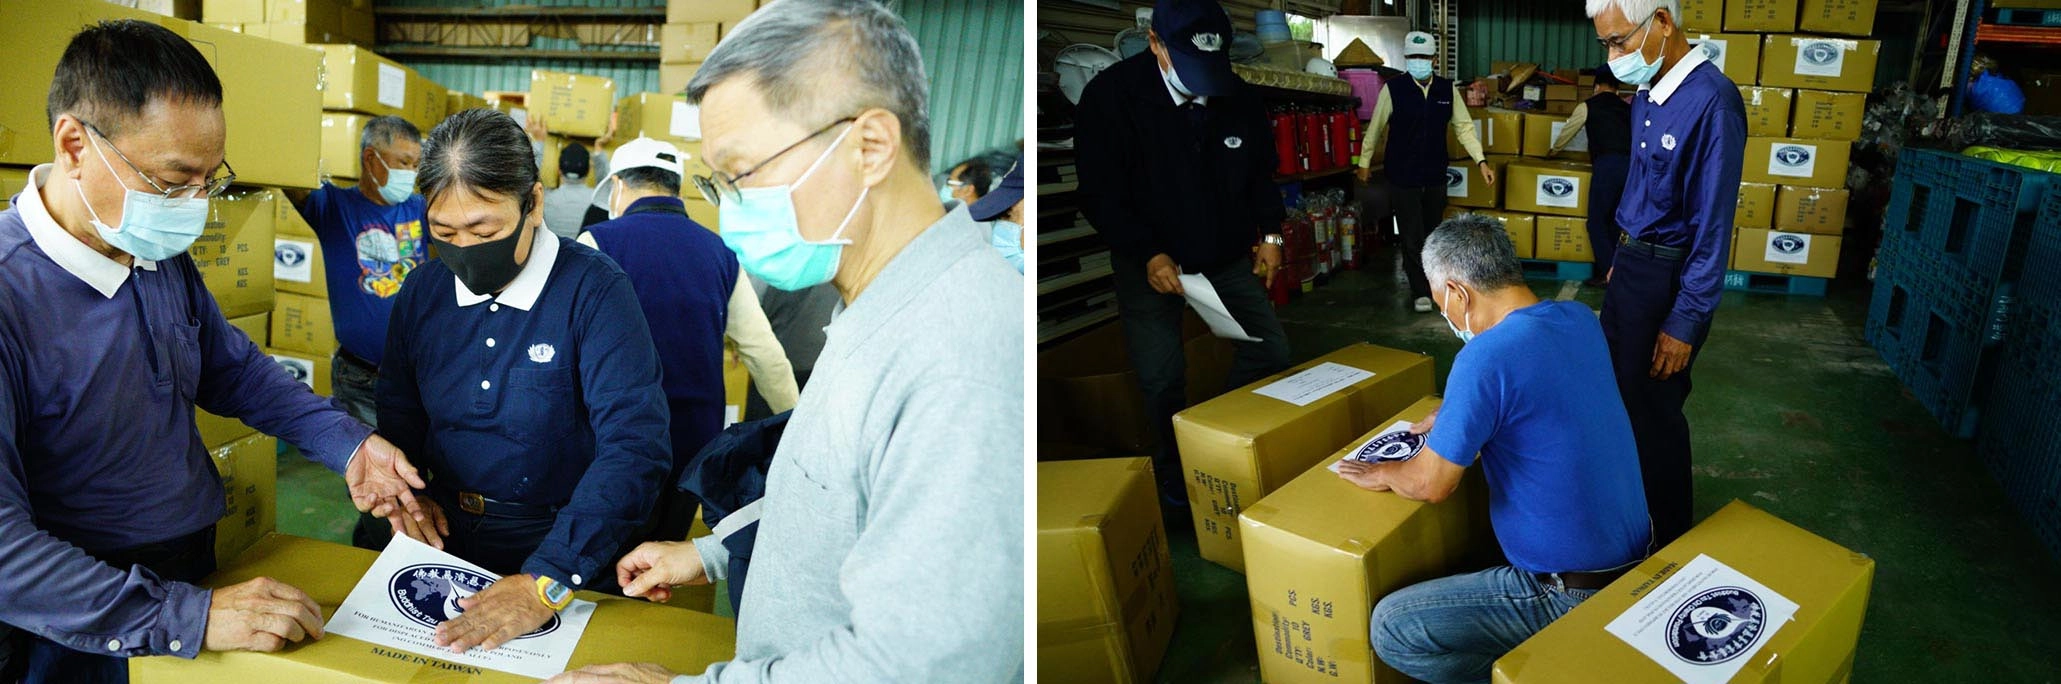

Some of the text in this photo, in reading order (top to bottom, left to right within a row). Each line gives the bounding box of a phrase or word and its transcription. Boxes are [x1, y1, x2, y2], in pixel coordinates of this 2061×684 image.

[354, 611, 369, 619] FOR
[397, 589, 438, 625] Buddhist Tzu
[1291, 621, 1299, 631] 10
[1302, 620, 1311, 641] GREY
[371, 647, 483, 675] MADE IN TAIWAN
